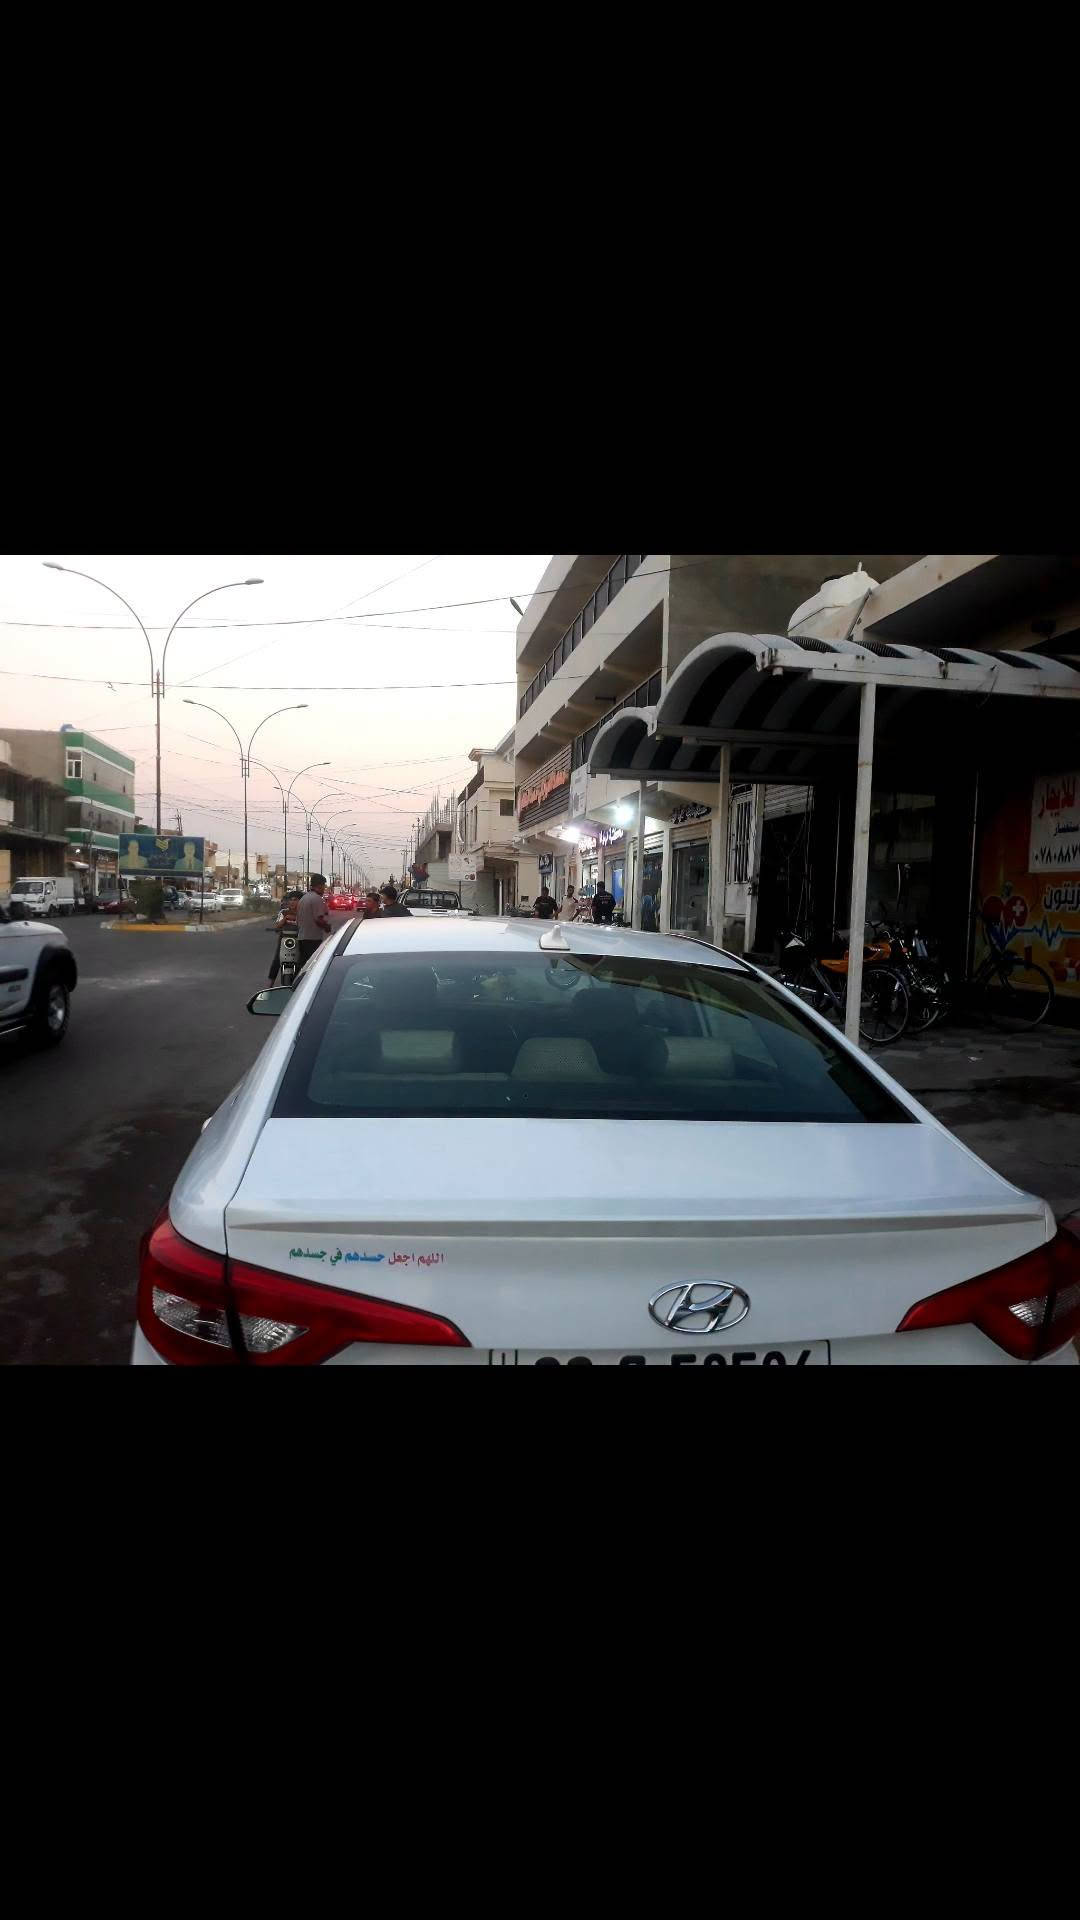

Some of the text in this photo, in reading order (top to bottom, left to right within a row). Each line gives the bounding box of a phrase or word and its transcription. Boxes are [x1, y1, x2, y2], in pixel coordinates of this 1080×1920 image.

[1035, 846, 1080, 864] ٠٧٨٠٨٨٧
[289, 1246, 444, 1268] اللهم اجعل حسدهم في جسدهم
